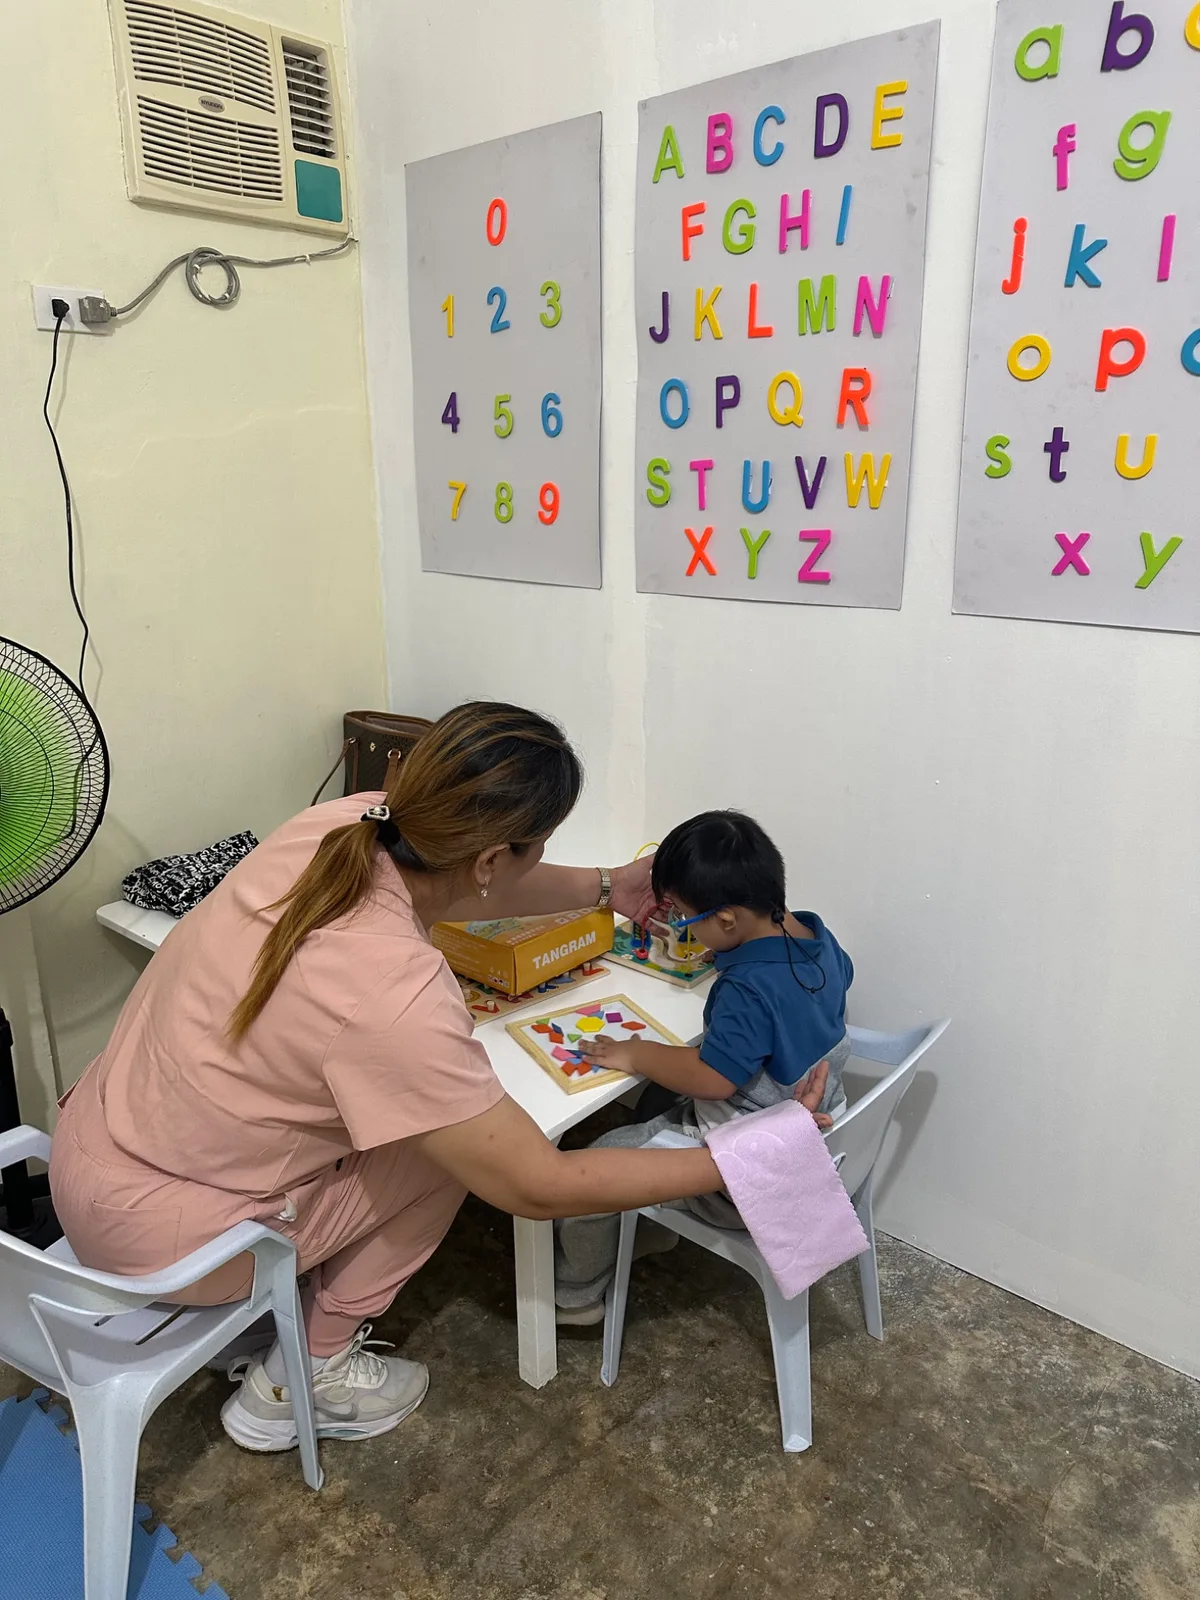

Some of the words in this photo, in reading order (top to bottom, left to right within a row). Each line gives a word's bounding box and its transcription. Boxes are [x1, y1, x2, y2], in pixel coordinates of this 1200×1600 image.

[1015, 25, 1063, 81] a
[1101, 2, 1154, 71] b
[653, 125, 684, 183] A
[706, 112, 734, 174] B
[754, 106, 785, 166] C
[815, 94, 848, 157] D
[871, 80, 908, 150] E
[1053, 124, 1076, 191] f
[1113, 110, 1171, 184] g
[486, 198, 508, 246] 0
[681, 202, 707, 261] F
[722, 198, 756, 254] G
[779, 189, 811, 253] H
[836, 185, 852, 244] I
[1001, 217, 1028, 295] j
[1065, 224, 1107, 287] k
[1157, 215, 1176, 281] l
[441, 294, 457, 337] 1
[486, 286, 510, 333] 2
[540, 281, 562, 328] 3
[650, 292, 670, 342] J
[694, 286, 723, 341] K
[747, 283, 774, 338] L
[798, 274, 836, 335] M
[853, 275, 891, 335] N
[1007, 334, 1052, 381] o
[1095, 328, 1147, 392] p
[441, 393, 460, 433] 4
[494, 394, 514, 438] 5
[541, 393, 563, 437] 6
[660, 378, 690, 429] O
[716, 376, 740, 427] P
[767, 371, 804, 428] Q
[836, 368, 873, 428] R
[647, 458, 672, 507] S
[689, 459, 714, 510] T
[742, 460, 772, 512] U
[796, 457, 826, 509] V
[844, 452, 892, 509] W
[985, 434, 1013, 478] s
[1044, 426, 1069, 482] t
[1114, 434, 1158, 480] u
[448, 480, 467, 520] 7
[494, 482, 513, 523] 8
[537, 482, 561, 526] 9
[684, 526, 718, 576] X
[740, 528, 771, 580] Y
[798, 529, 832, 583] Z
[1052, 532, 1090, 575] x
[1135, 532, 1182, 589] y
[532, 931, 597, 970] TANGRAM
